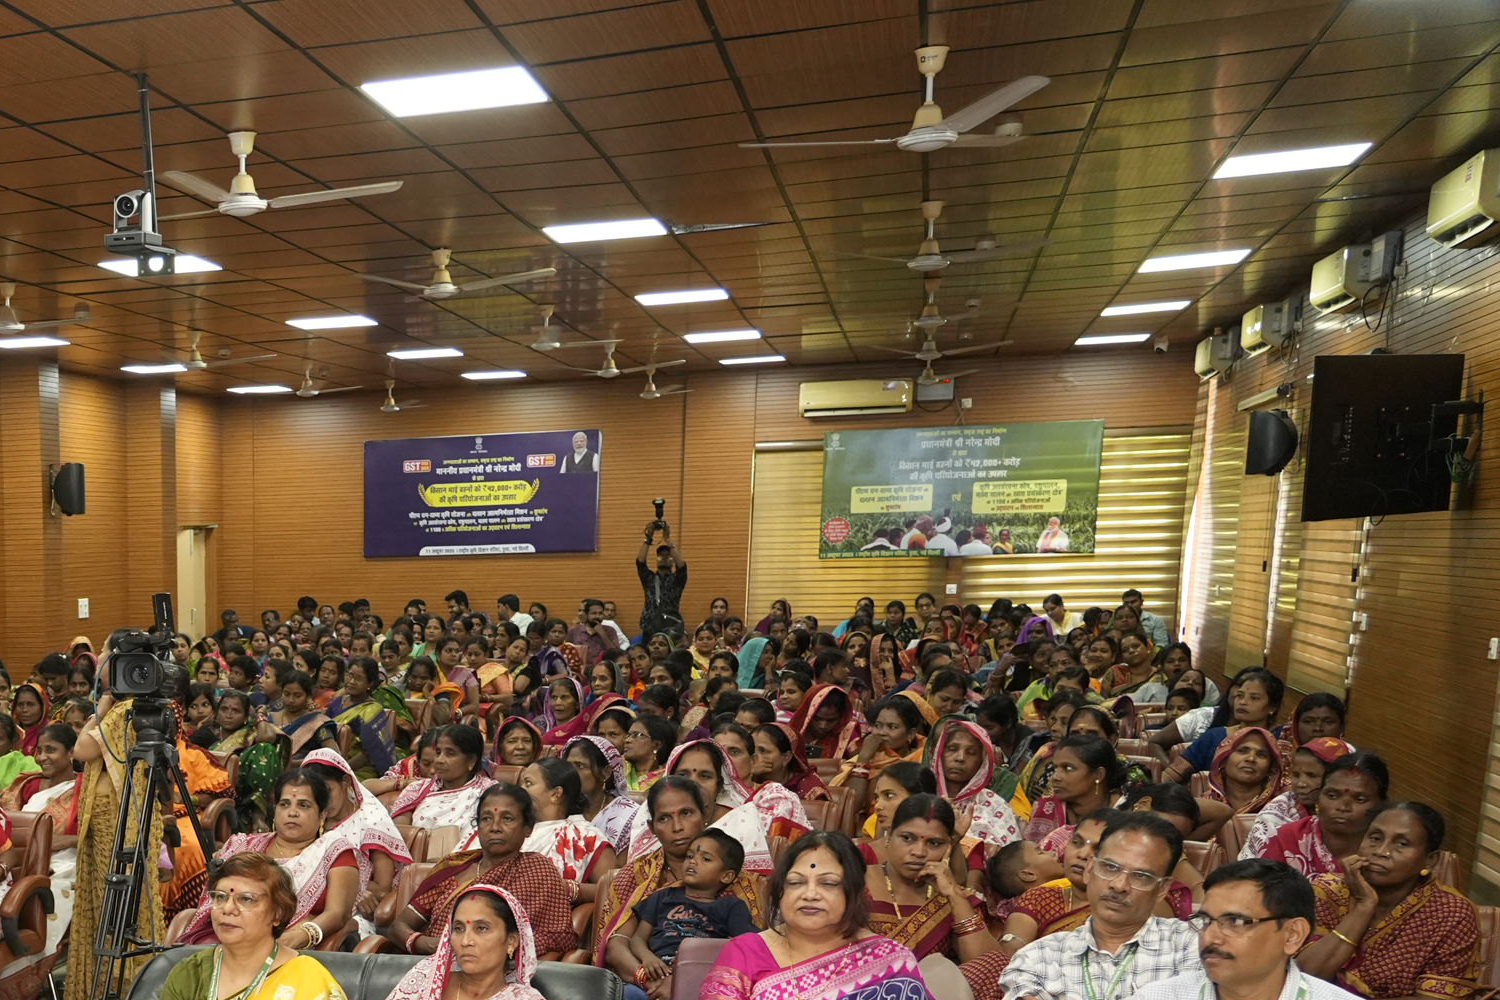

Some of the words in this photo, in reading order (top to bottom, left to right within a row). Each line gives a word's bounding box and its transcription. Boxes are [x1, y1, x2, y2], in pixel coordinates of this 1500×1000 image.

[921, 438, 953, 449] प्रधानमंत्री
[955, 437, 963, 447] श्री
[984, 436, 1001, 446] मोदी
[529, 456, 545, 465] GST
[405, 462, 421, 470] GST
[508, 463, 521, 471] मोदी
[448, 485, 458, 493] भाई
[252, 971, 264, 987] Agriculture
